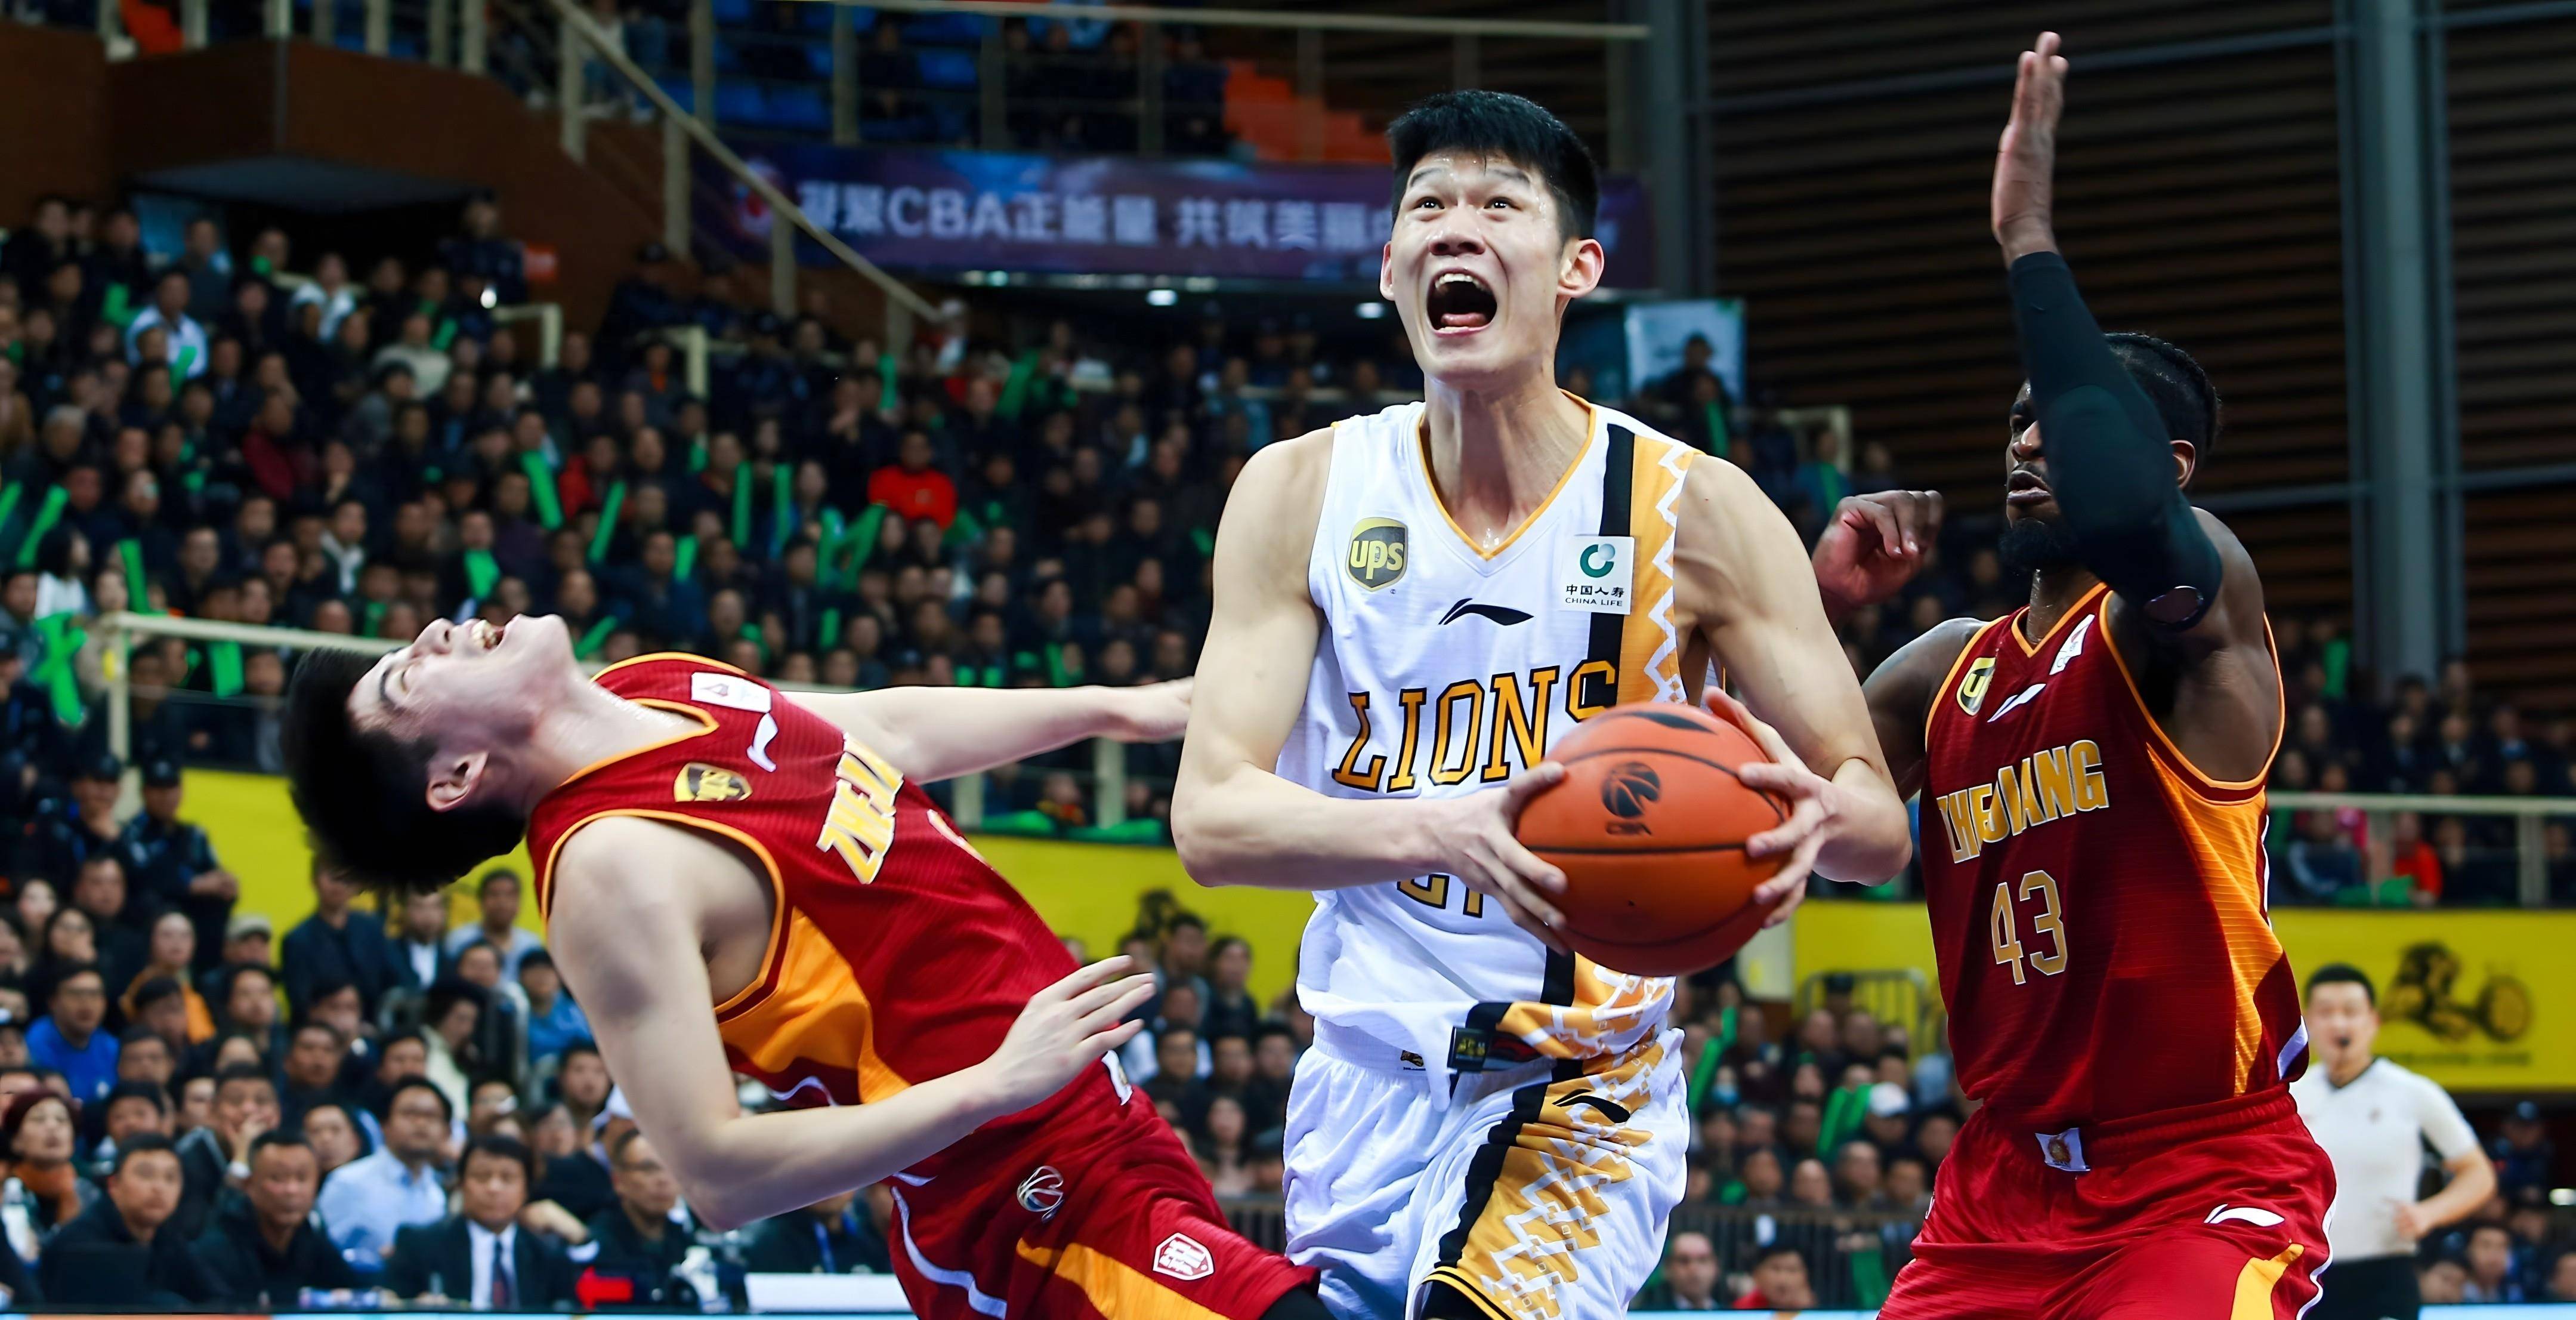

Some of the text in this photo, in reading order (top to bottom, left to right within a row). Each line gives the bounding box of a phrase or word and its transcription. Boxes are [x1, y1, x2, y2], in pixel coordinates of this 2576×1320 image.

[1565, 584, 1624, 598] 中国人寿
[1990, 869, 2068, 985] 43
